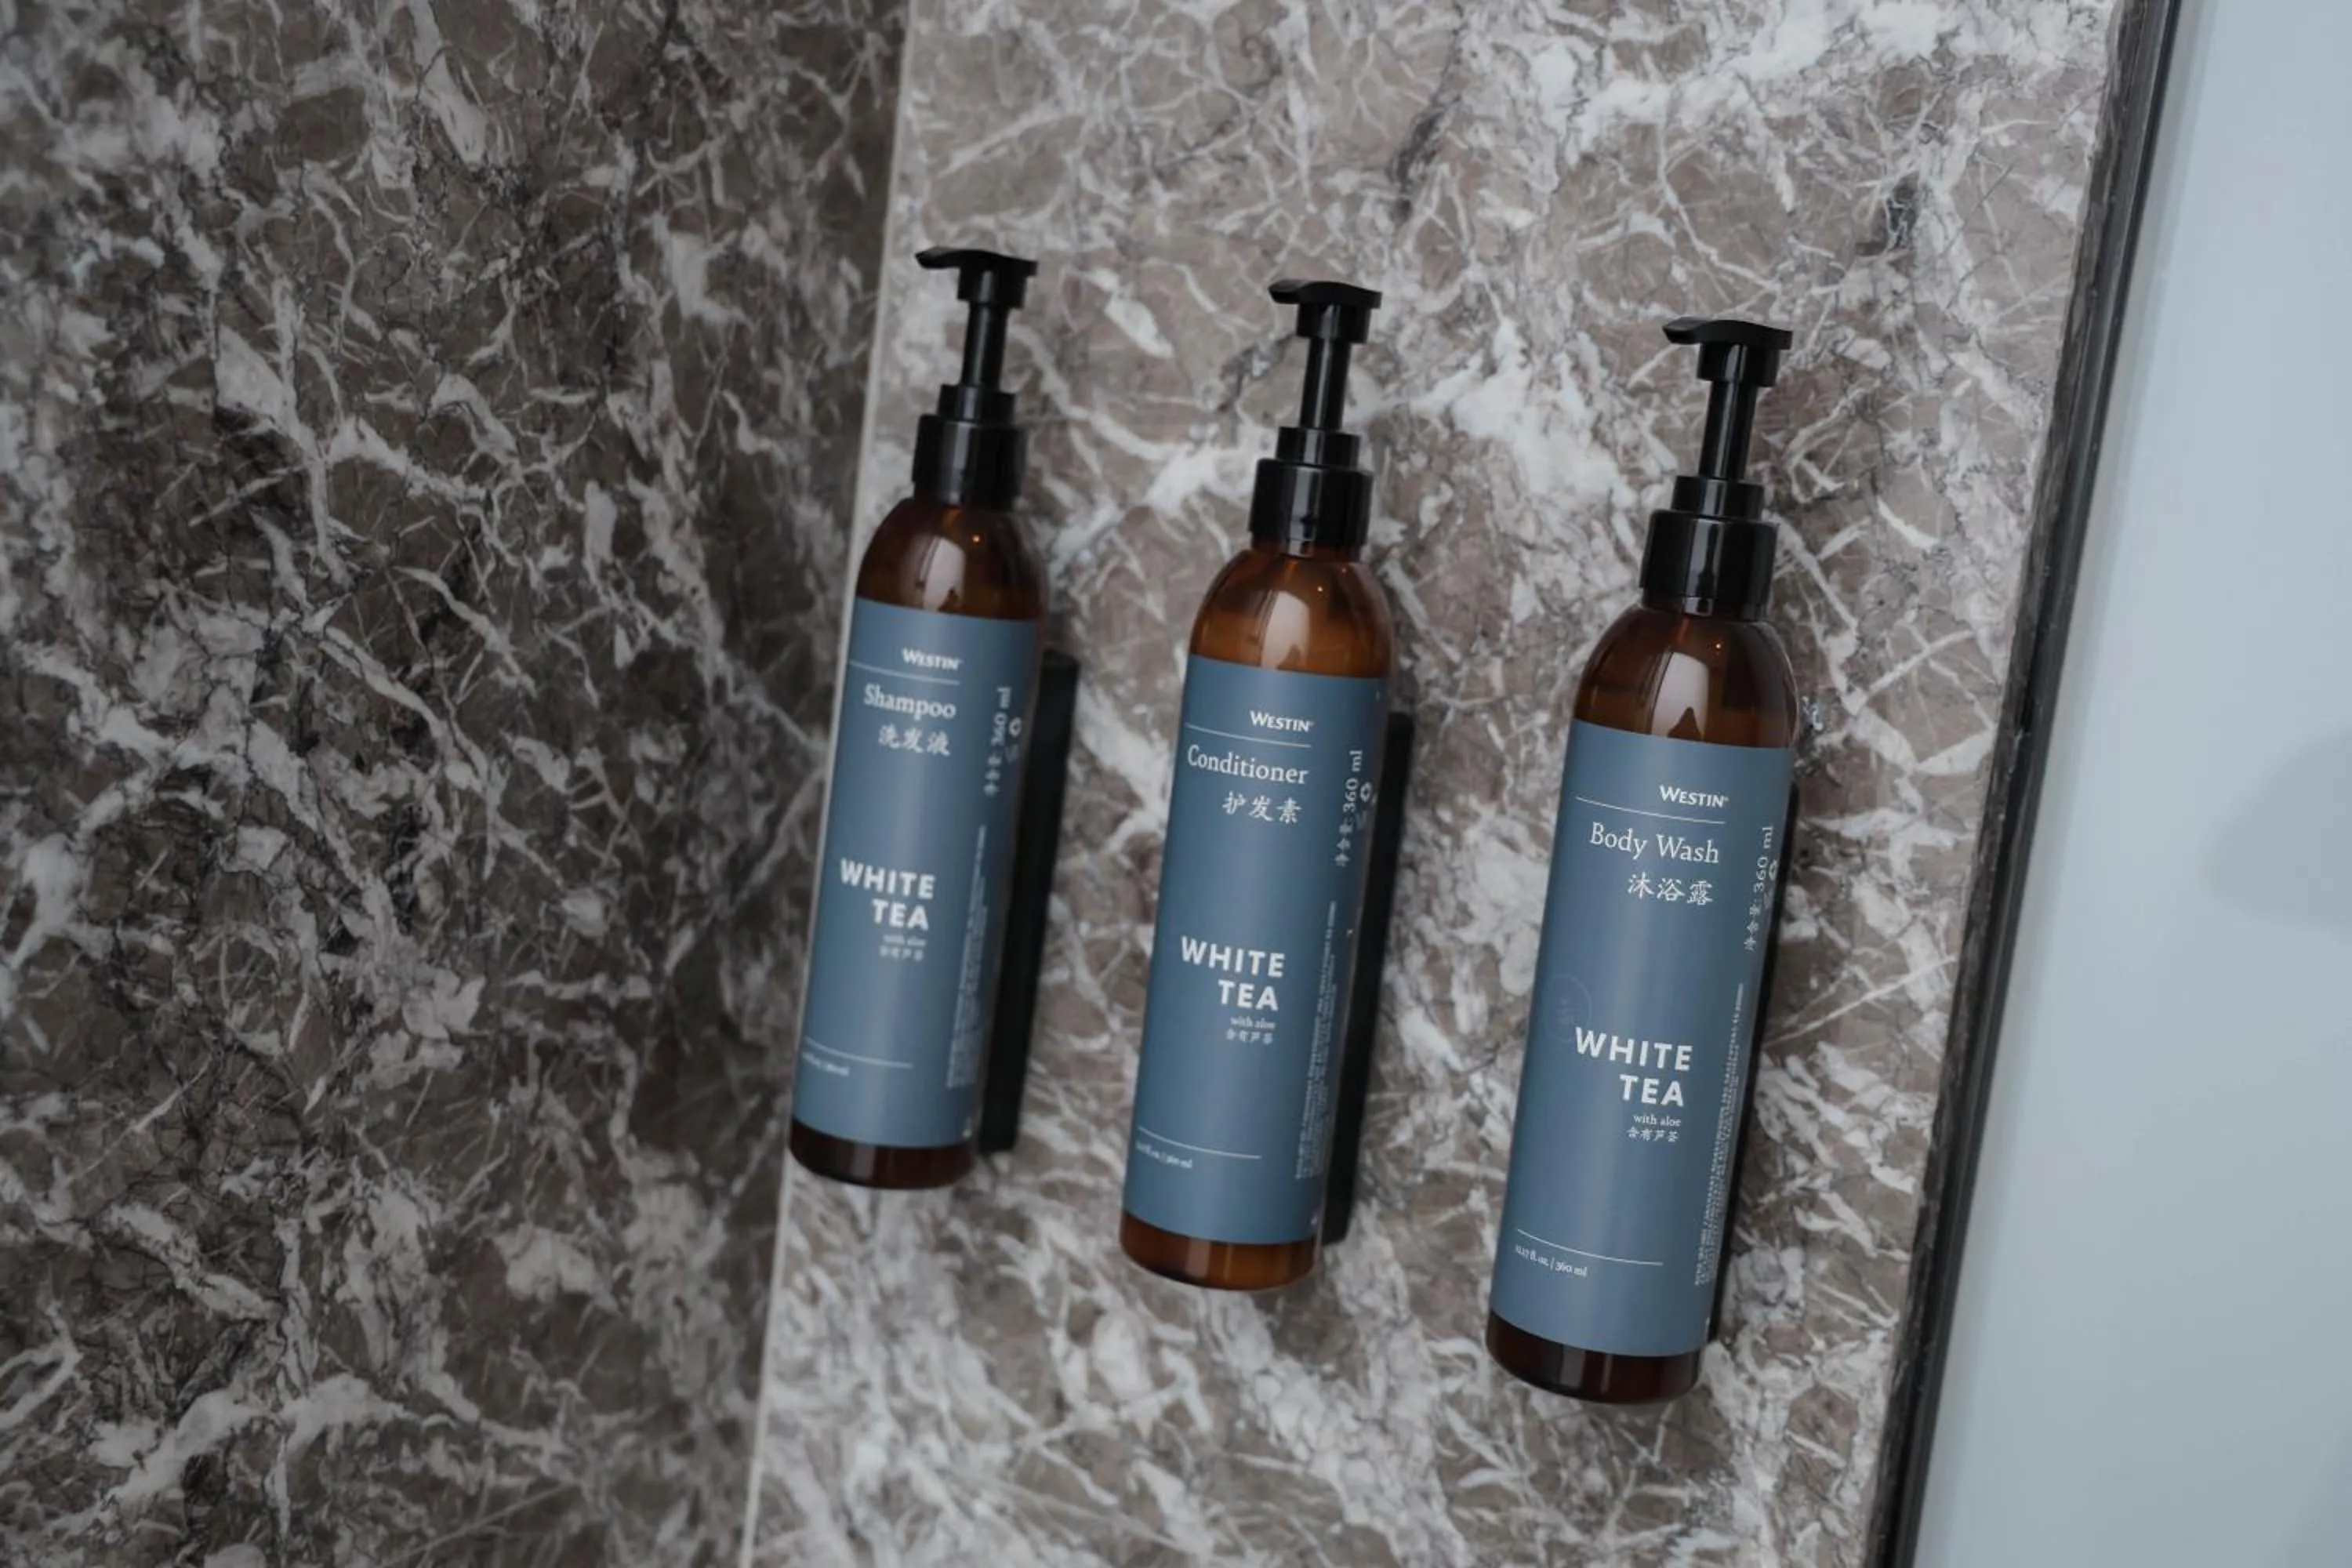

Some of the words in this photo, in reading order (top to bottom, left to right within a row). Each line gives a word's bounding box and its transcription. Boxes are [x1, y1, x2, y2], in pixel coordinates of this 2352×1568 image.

[864, 683, 956, 720] Shampoo
[1187, 745, 1308, 784] Conditioner
[1348, 750, 1363, 772] ml
[1222, 790, 1302, 824] 护发素
[1342, 777, 1358, 813] 360
[1590, 822, 1647, 859] Body
[1656, 834, 1719, 863] Wash
[1754, 856, 1769, 893] 360
[1762, 826, 1773, 849] ml
[840, 858, 936, 899] WHITE
[1628, 871, 1712, 906] 沐浴露
[872, 899, 928, 931] TEA
[1181, 935, 1285, 978] WHITE
[1218, 980, 1279, 1011] TEA
[1575, 1027, 1693, 1072] WHITE
[1620, 1074, 1683, 1107] TEA
[1633, 1112, 1657, 1125] with
[1660, 1115, 1682, 1127] aloe
[1573, 1266, 1588, 1278] ml
